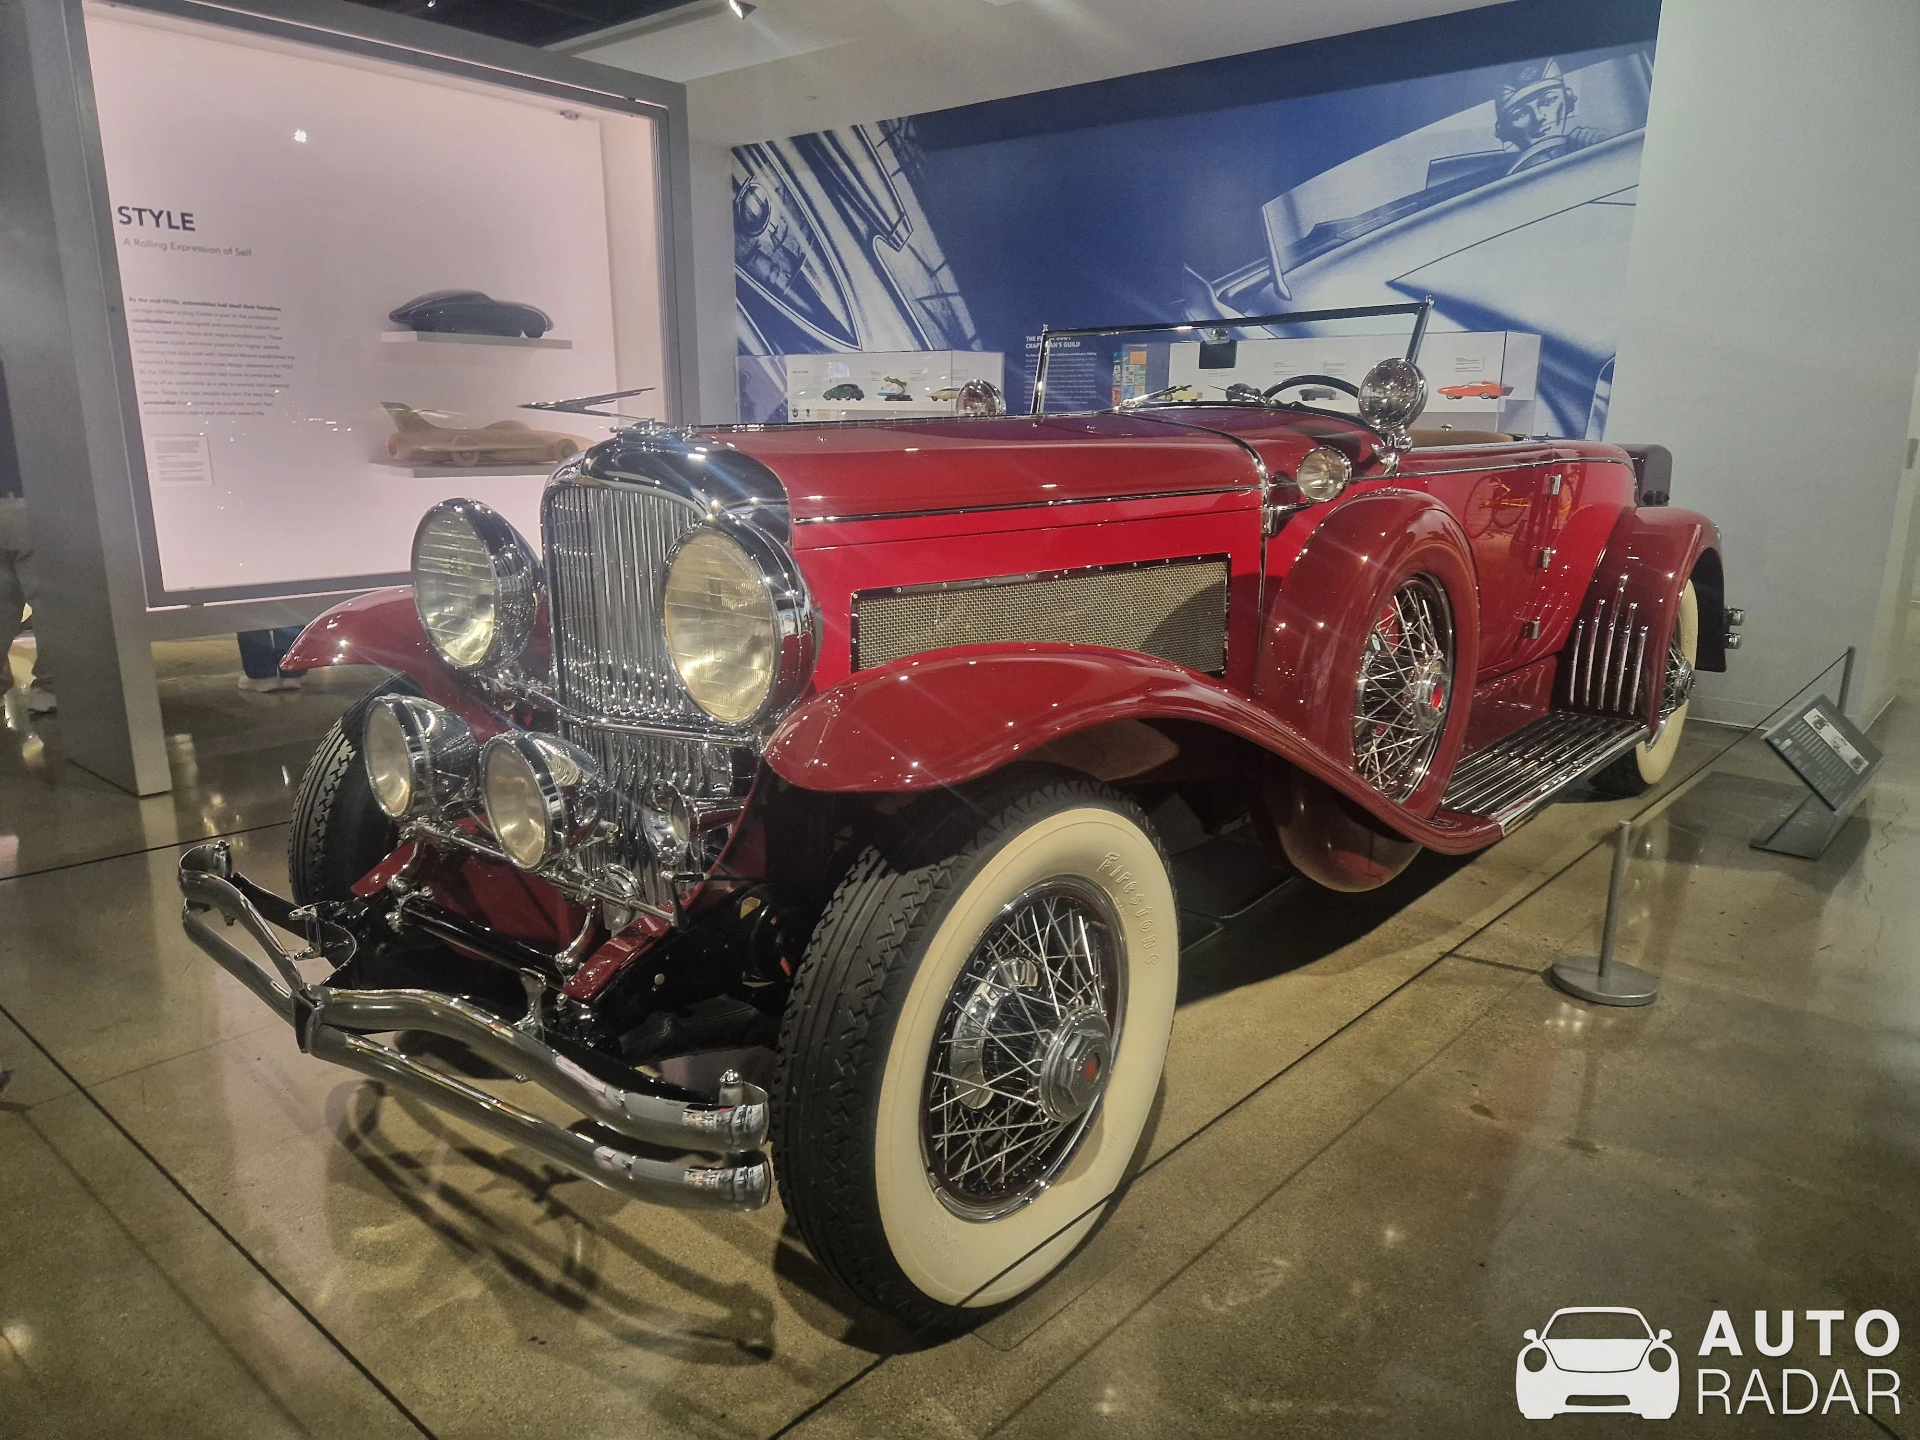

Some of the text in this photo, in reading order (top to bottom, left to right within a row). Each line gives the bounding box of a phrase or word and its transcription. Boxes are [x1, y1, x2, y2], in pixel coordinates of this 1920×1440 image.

[117, 205, 196, 232] STYLE
[123, 237, 252, 257] A Rolling Expression of Self
[1095, 851, 1160, 965] Firestone
